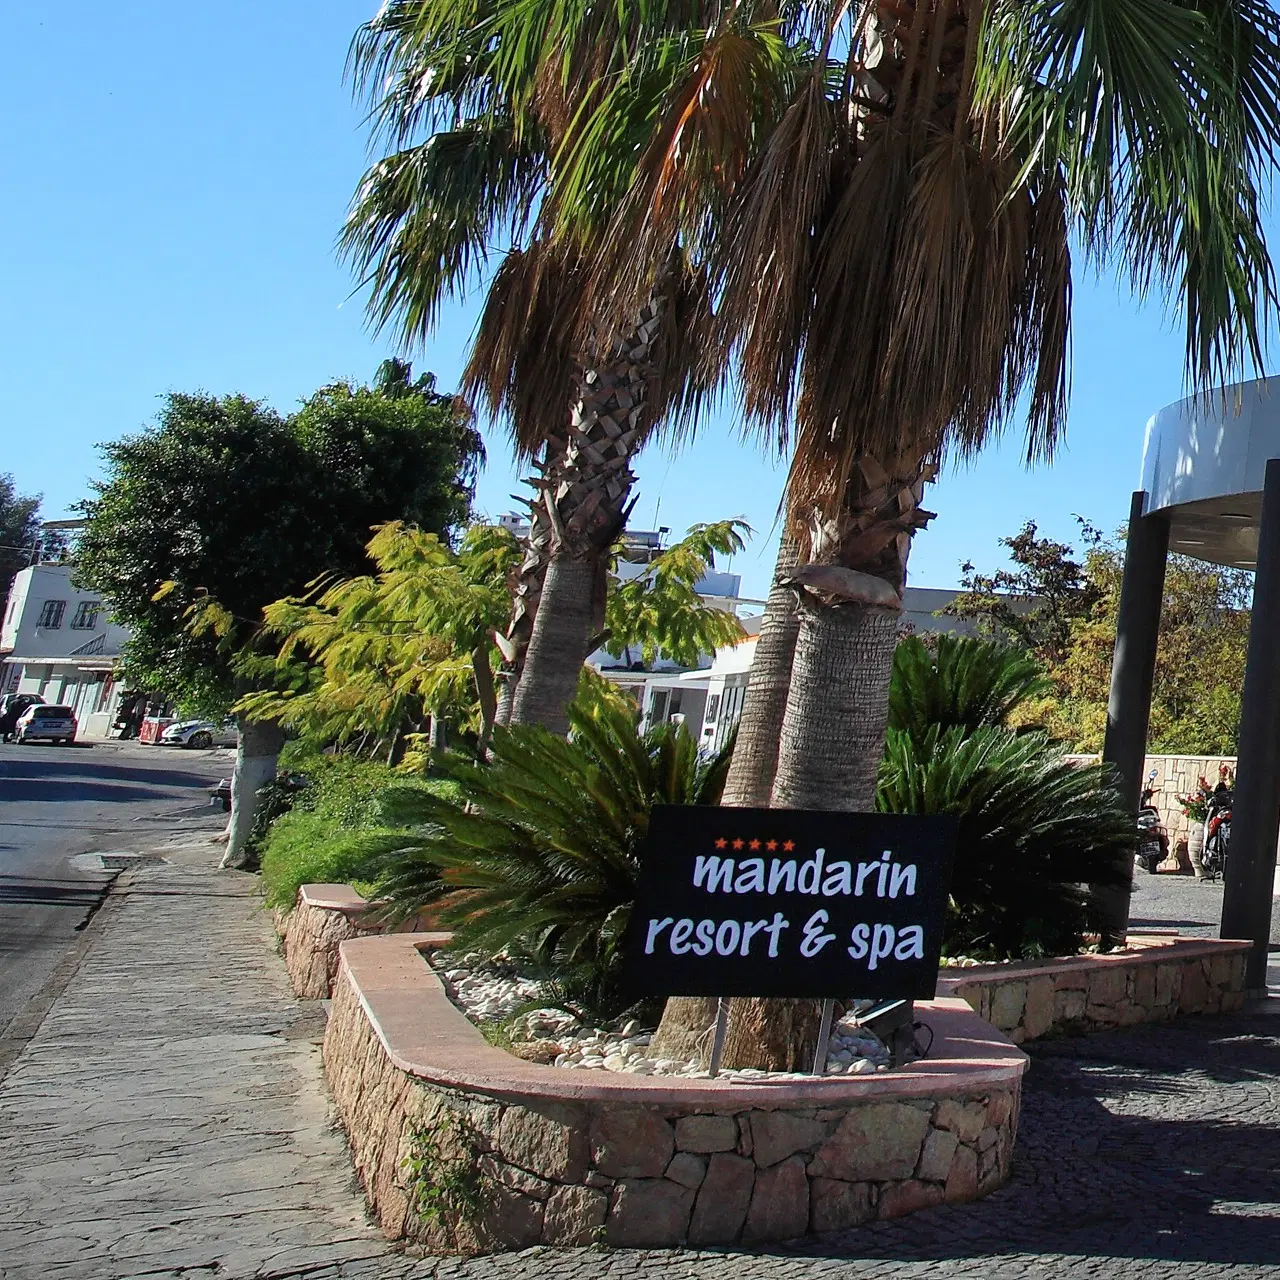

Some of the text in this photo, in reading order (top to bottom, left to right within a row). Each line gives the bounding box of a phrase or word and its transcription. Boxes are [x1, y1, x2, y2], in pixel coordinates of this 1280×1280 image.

[693, 848, 917, 899] mandarin
[644, 908, 924, 970] resort & spa
